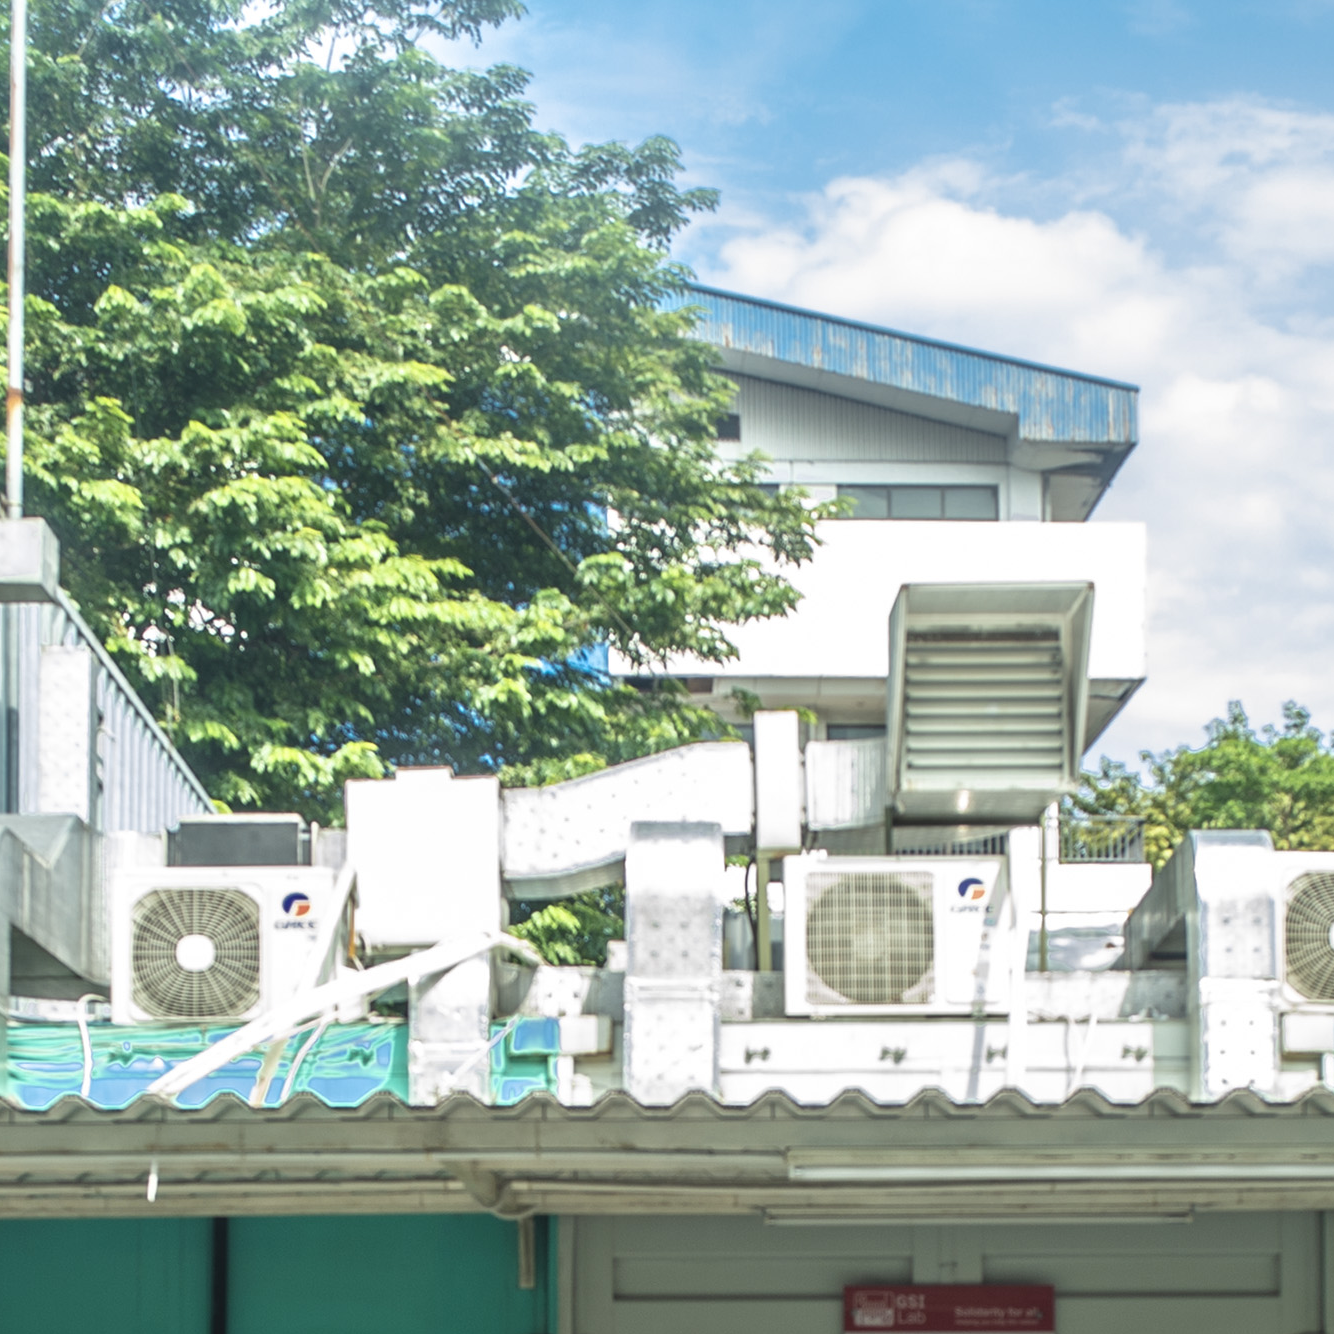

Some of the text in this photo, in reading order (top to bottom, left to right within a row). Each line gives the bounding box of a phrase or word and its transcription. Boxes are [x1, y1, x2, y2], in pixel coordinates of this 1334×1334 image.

[895, 1293, 926, 1310] GSI
[896, 1309, 927, 1325] Lab
[953, 1306, 1005, 1319] Solidarity
[1007, 1306, 1023, 1317] for
